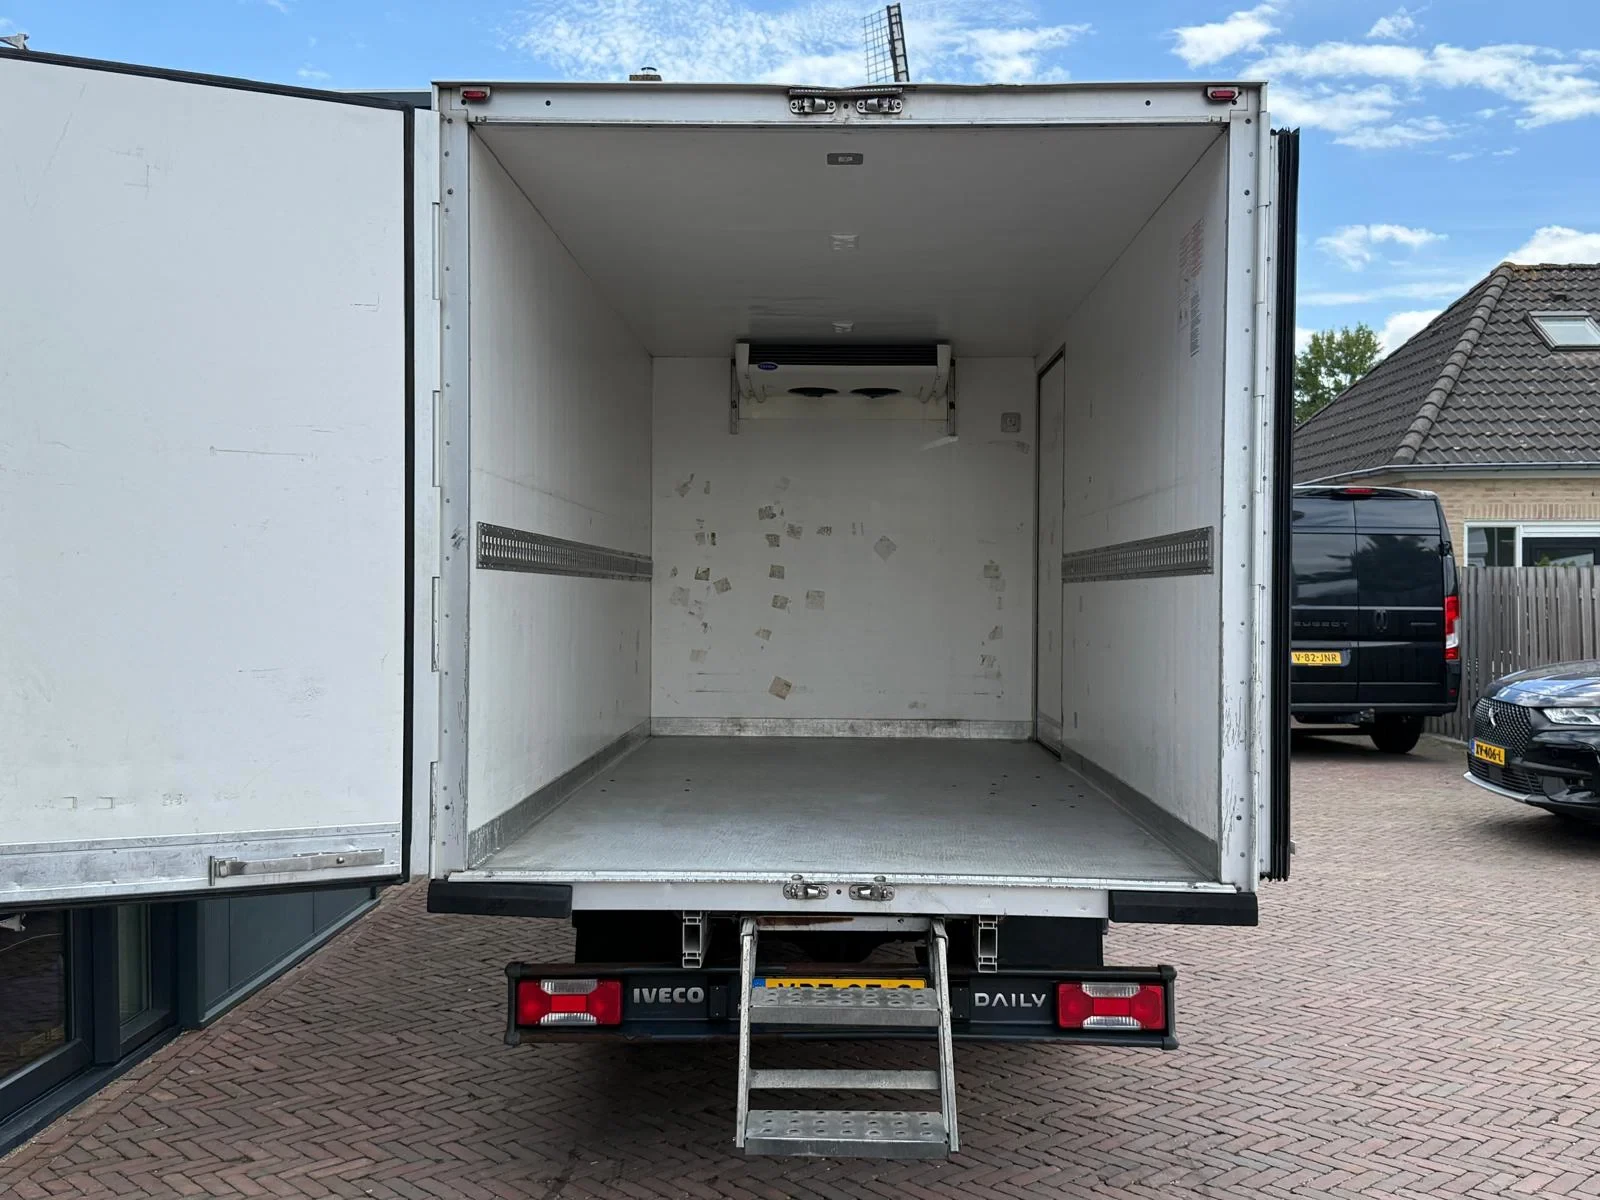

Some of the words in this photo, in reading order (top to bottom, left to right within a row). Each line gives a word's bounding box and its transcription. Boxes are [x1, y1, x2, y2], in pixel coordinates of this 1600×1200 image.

[1293, 620, 1349, 628] EUGEOT
[1294, 653, 1337, 663] V-82-JNR
[633, 987, 704, 1003] IVECO
[974, 992, 1046, 1008] DAILY
